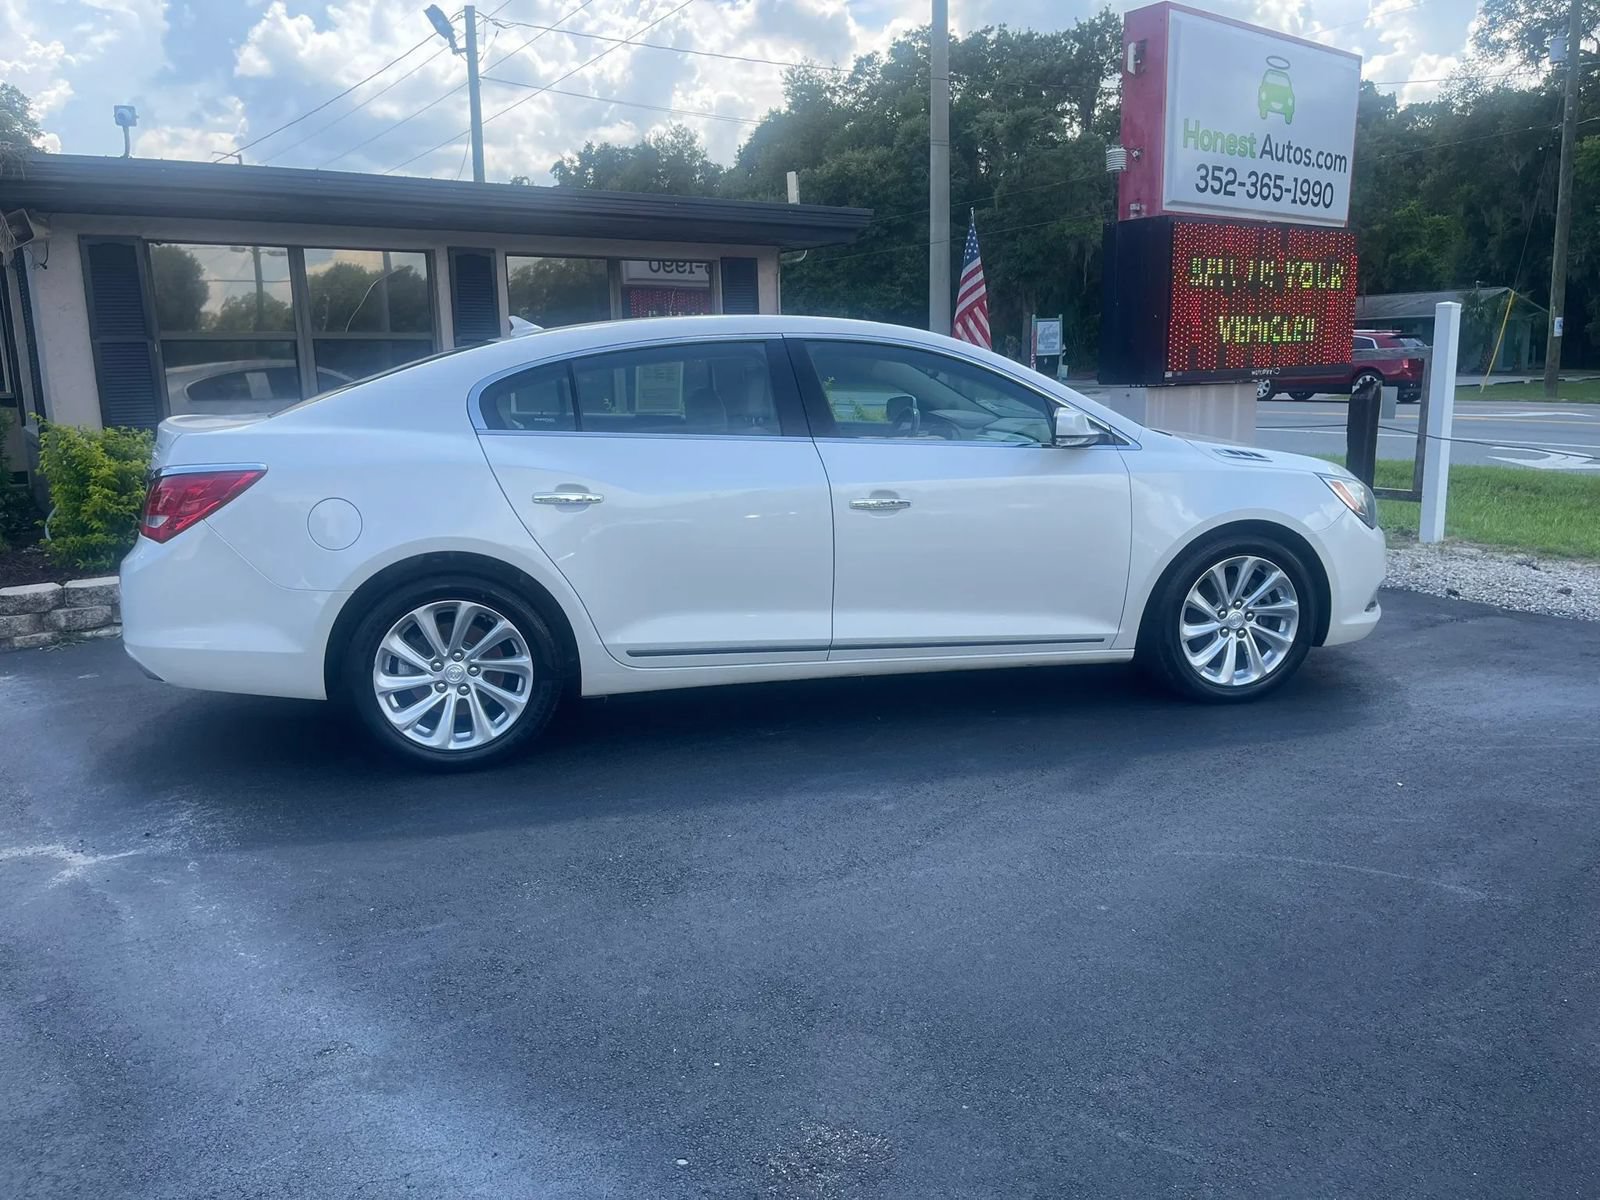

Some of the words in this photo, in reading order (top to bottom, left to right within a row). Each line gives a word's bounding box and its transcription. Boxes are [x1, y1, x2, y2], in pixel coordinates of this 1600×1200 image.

[1183, 118, 1257, 159] Honest
[1259, 133, 1347, 173] Autos.com
[1195, 163, 1334, 209] 352-365-1990
[1218, 315, 1315, 343] VEHICLE!!
